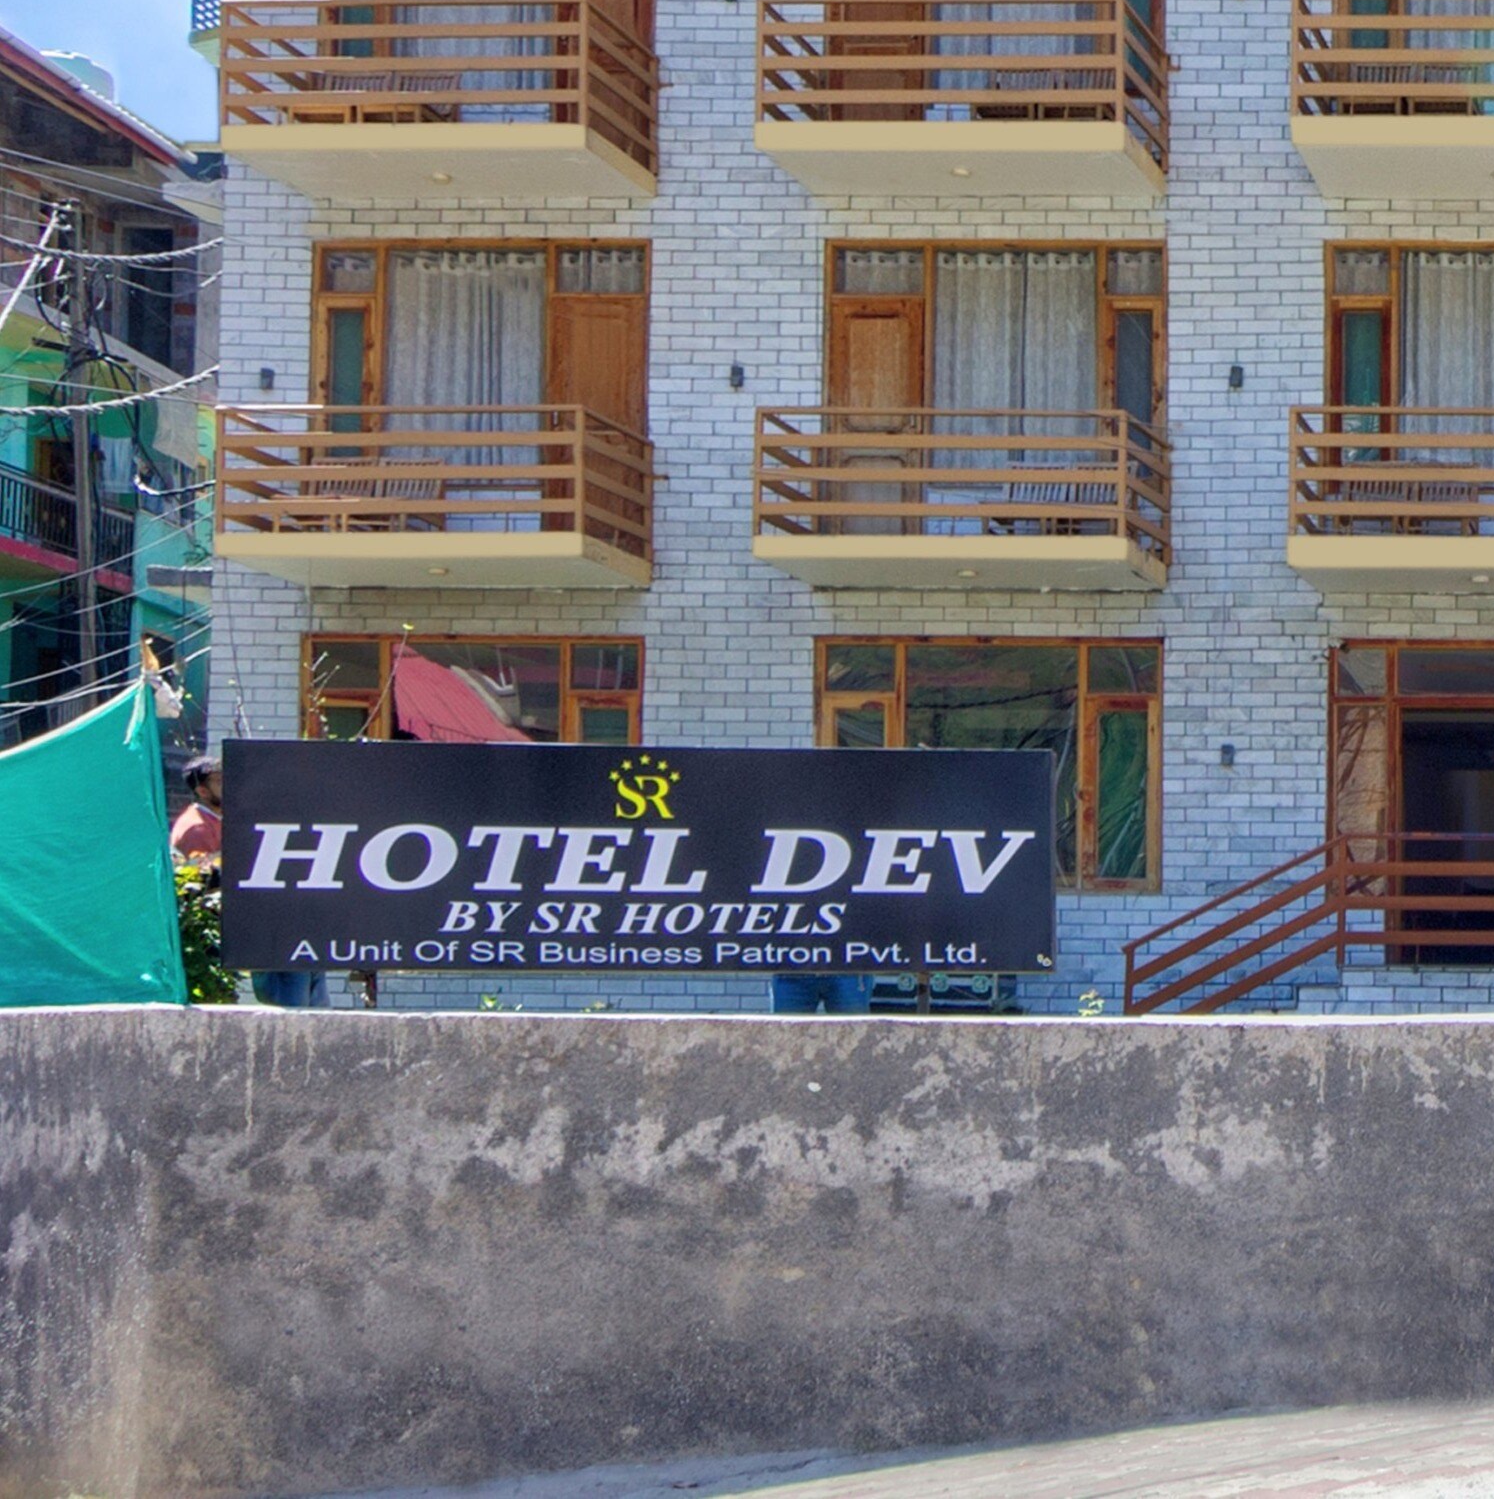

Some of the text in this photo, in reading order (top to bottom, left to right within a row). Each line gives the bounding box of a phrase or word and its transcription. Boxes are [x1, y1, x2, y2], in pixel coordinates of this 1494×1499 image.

[616, 776, 675, 819] SR
[238, 823, 1036, 894] HOTEL DEV
[440, 901, 847, 934] BY SR HOTELS
[290, 940, 987, 963] A Unit Of SR Business Patron Pvt. Ltd.
